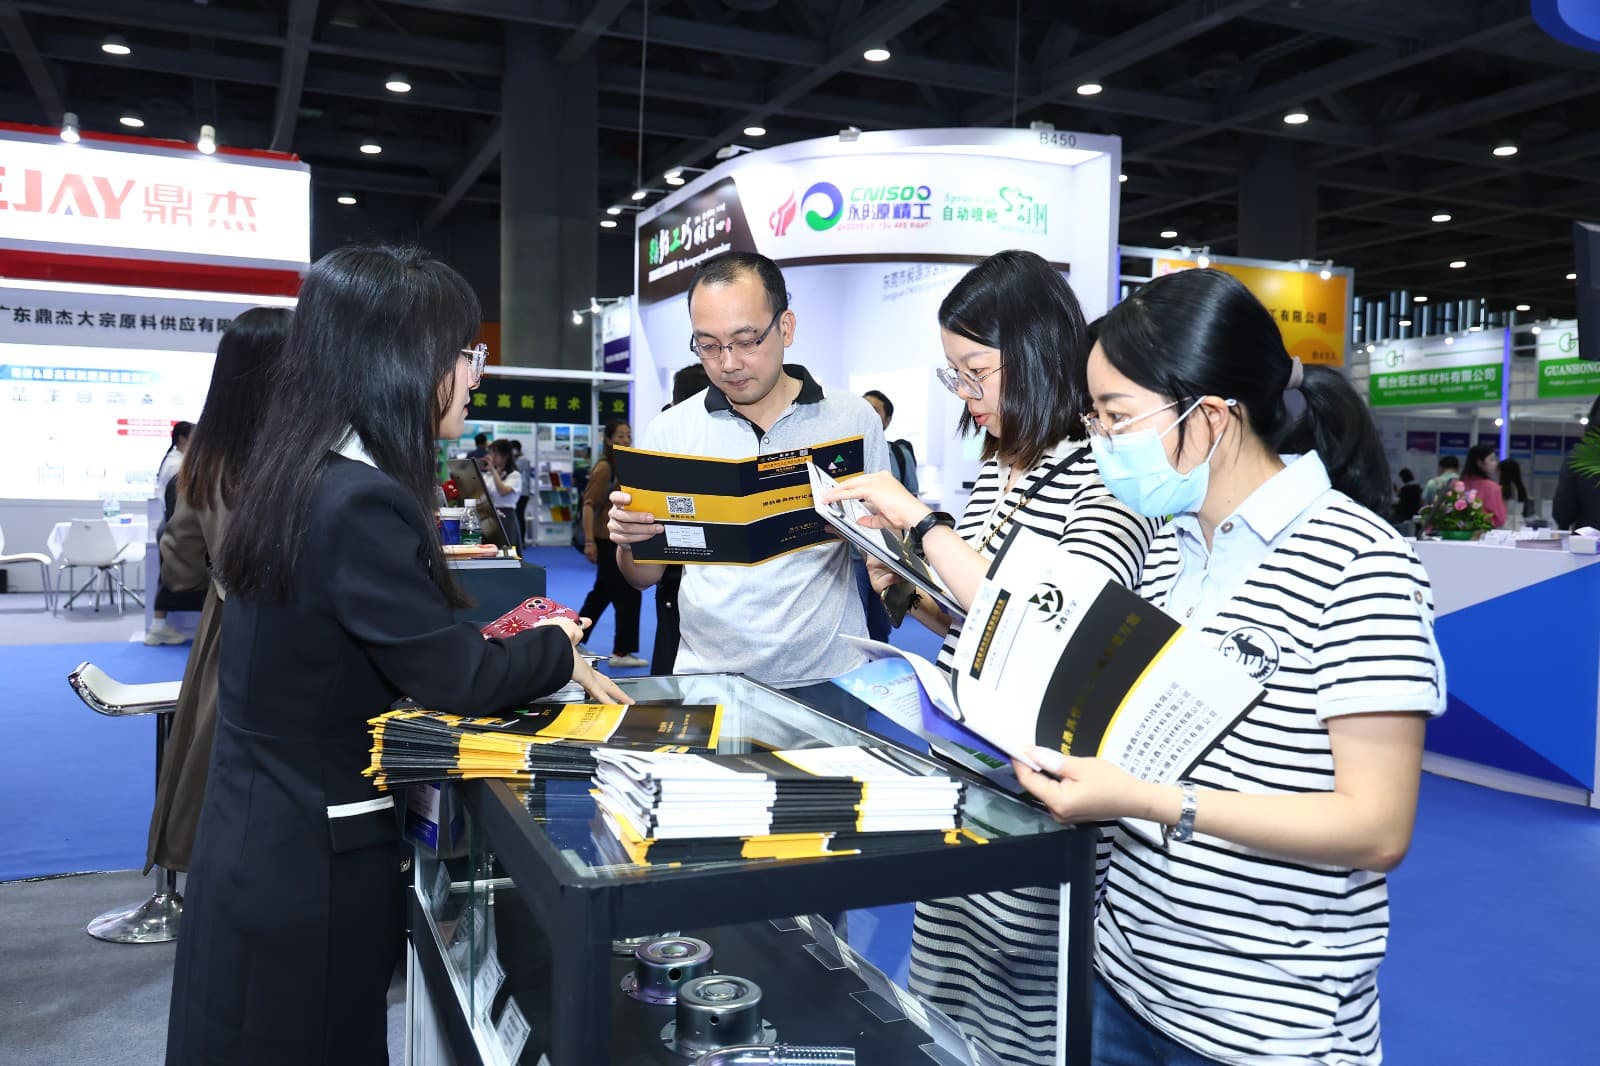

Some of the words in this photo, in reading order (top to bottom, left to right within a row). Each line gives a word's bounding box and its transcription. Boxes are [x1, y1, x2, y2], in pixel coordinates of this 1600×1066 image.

[1040, 131, 1077, 147] B450
[143, 183, 258, 233] 鼎杰
[473, 392, 625, 413] 家高新技术业
